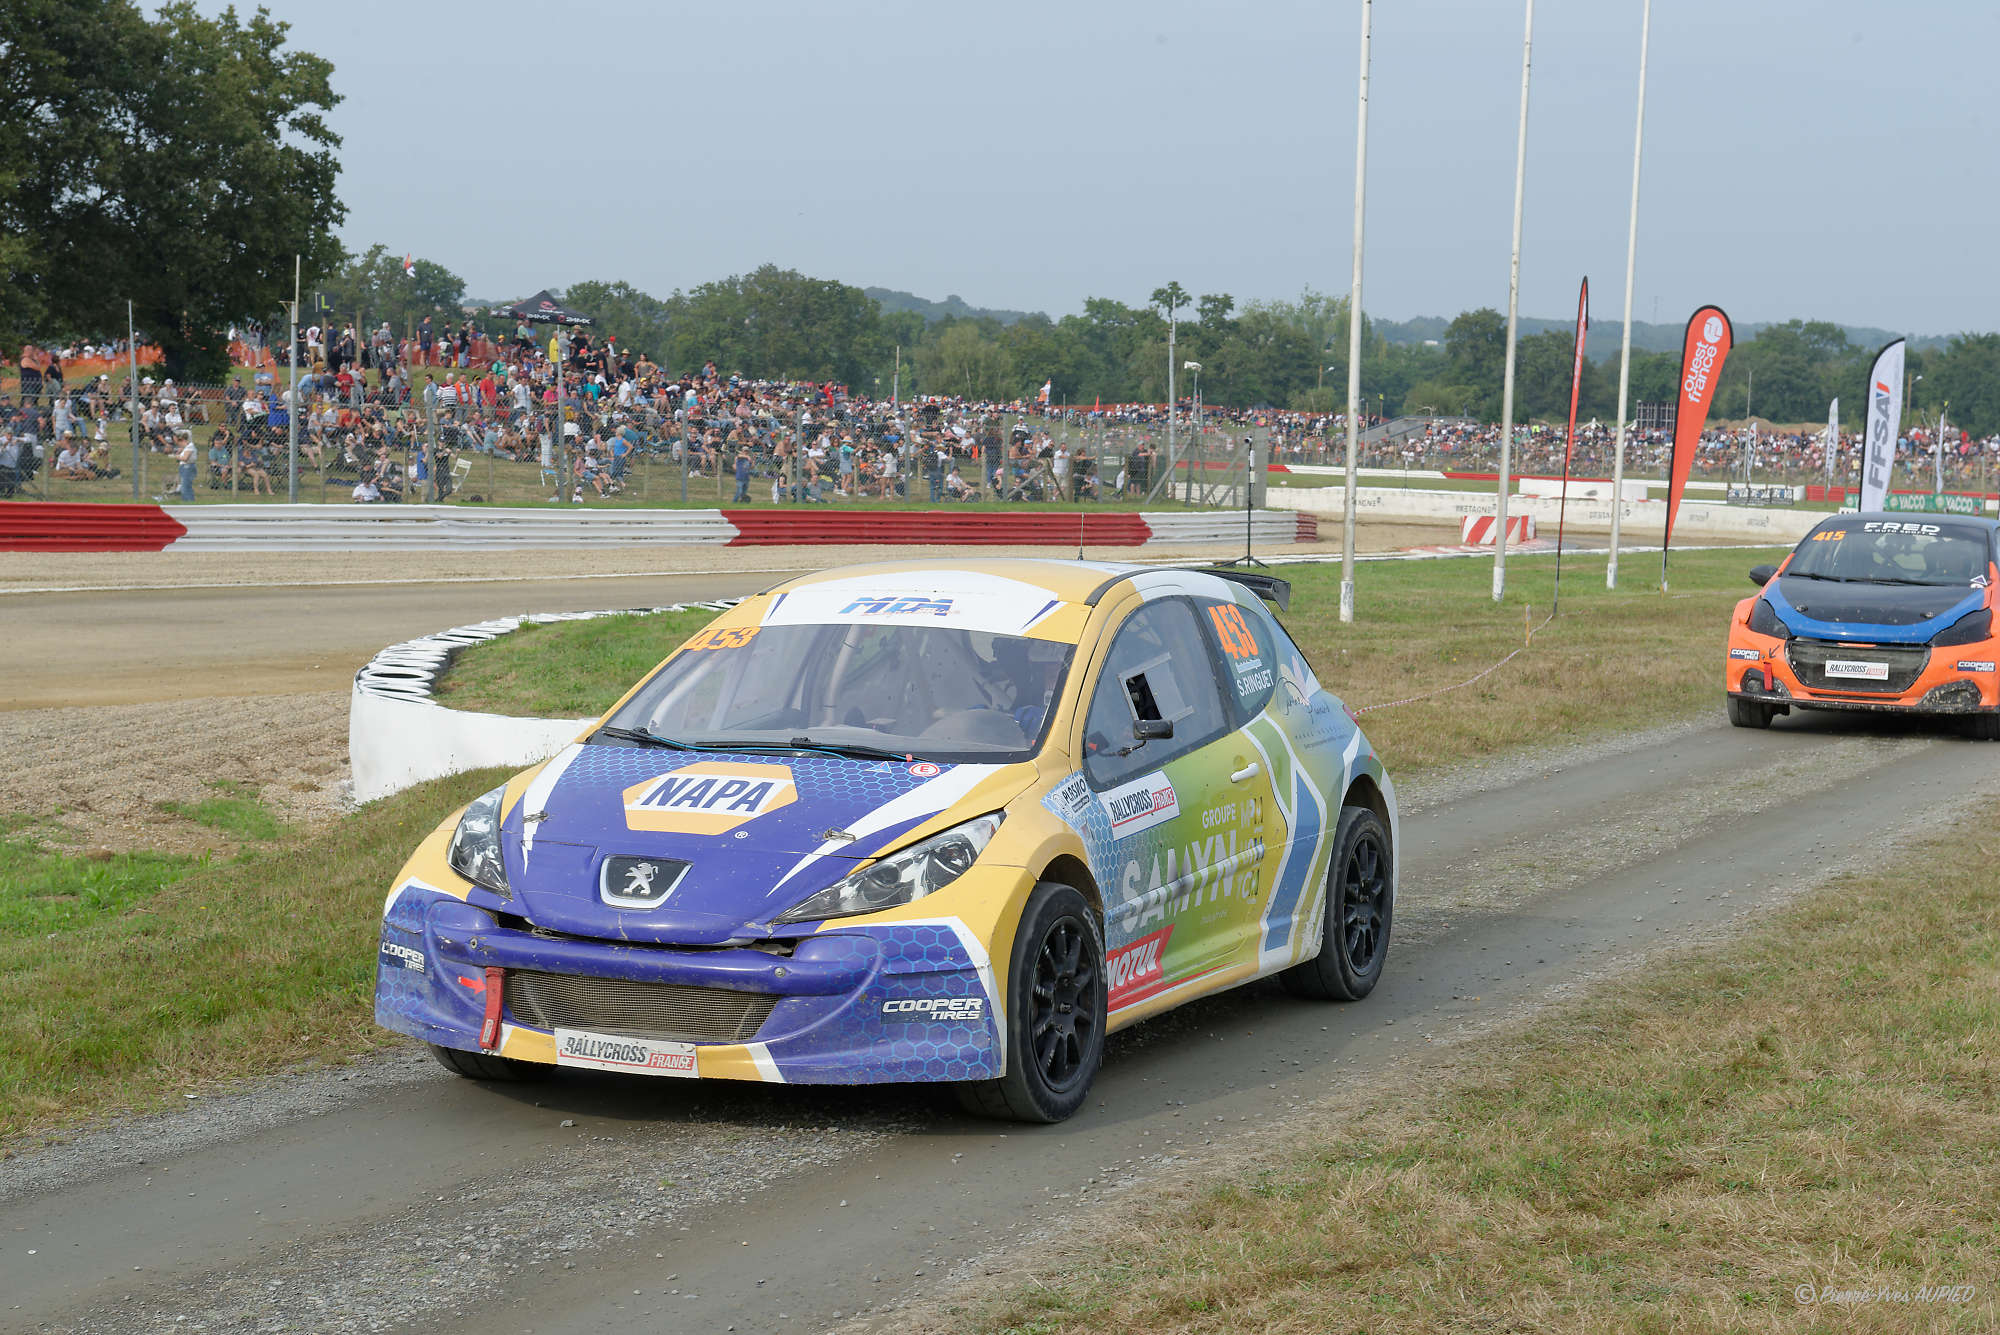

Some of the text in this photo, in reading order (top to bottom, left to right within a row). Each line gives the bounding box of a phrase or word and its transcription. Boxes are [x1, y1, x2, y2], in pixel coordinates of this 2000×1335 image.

[1684, 340, 1709, 392] ouest
[1688, 345, 1717, 403] france
[1868, 392, 1890, 490] FFSA
[1899, 495, 1926, 509] YACCO
[1946, 496, 1974, 512] YACCO
[1812, 530, 1847, 541] 415
[1864, 522, 1941, 534] FRED
[685, 627, 761, 651] 453
[1208, 603, 1259, 660] 453
[1829, 664, 1867, 673] RALLYCROSS
[1236, 669, 1274, 697] S.RINGUET
[640, 777, 774, 812] NAPA
[1109, 788, 1154, 822] RALLYCROSS
[1202, 803, 1236, 829] GROUPE
[1122, 829, 1238, 933] SAMYN
[381, 941, 425, 965] COOPER
[404, 959, 425, 973] TIRES
[1107, 938, 1161, 992] MOTUL
[882, 998, 983, 1013] COOPER
[929, 1010, 980, 1020] TIRES
[565, 1036, 693, 1070] RALLYCROSS FRANCE
